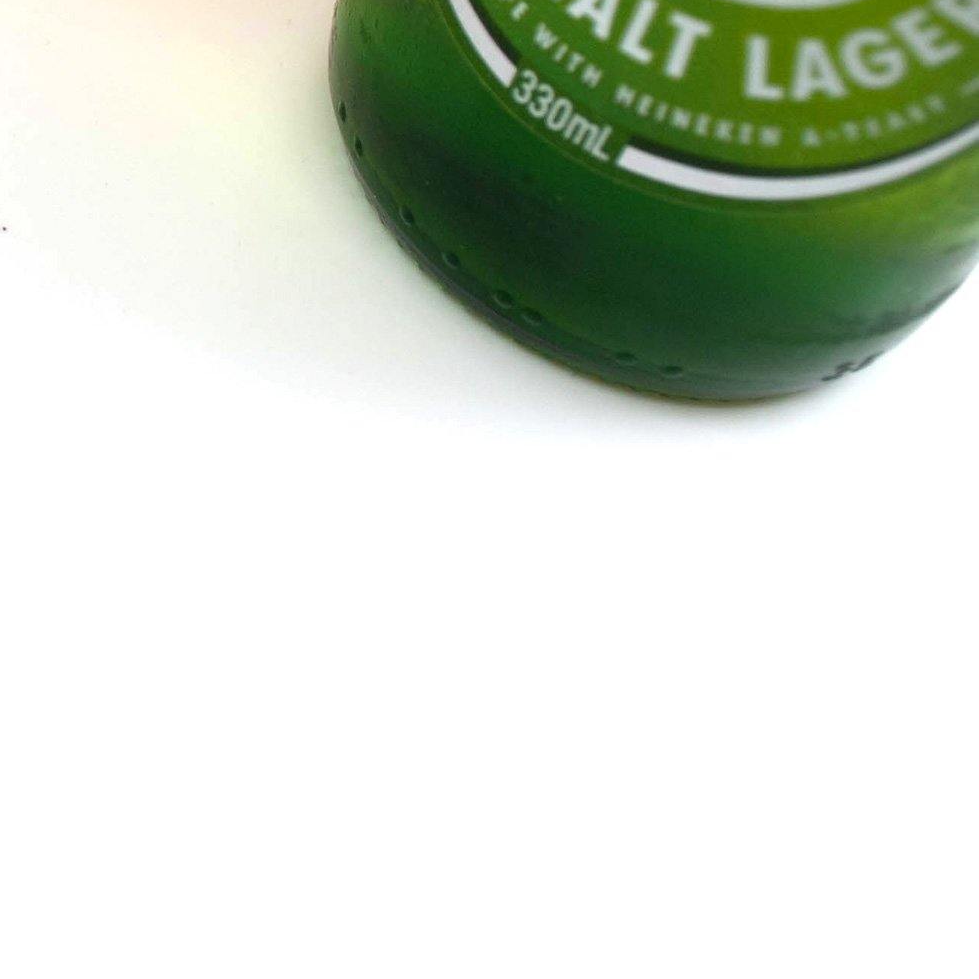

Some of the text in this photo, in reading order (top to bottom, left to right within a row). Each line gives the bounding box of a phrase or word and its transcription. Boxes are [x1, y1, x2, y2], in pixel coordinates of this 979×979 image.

[512, 70, 612, 161] 330mL
[534, 22, 602, 88] WITH
[615, 85, 782, 147] HEINEKEN
